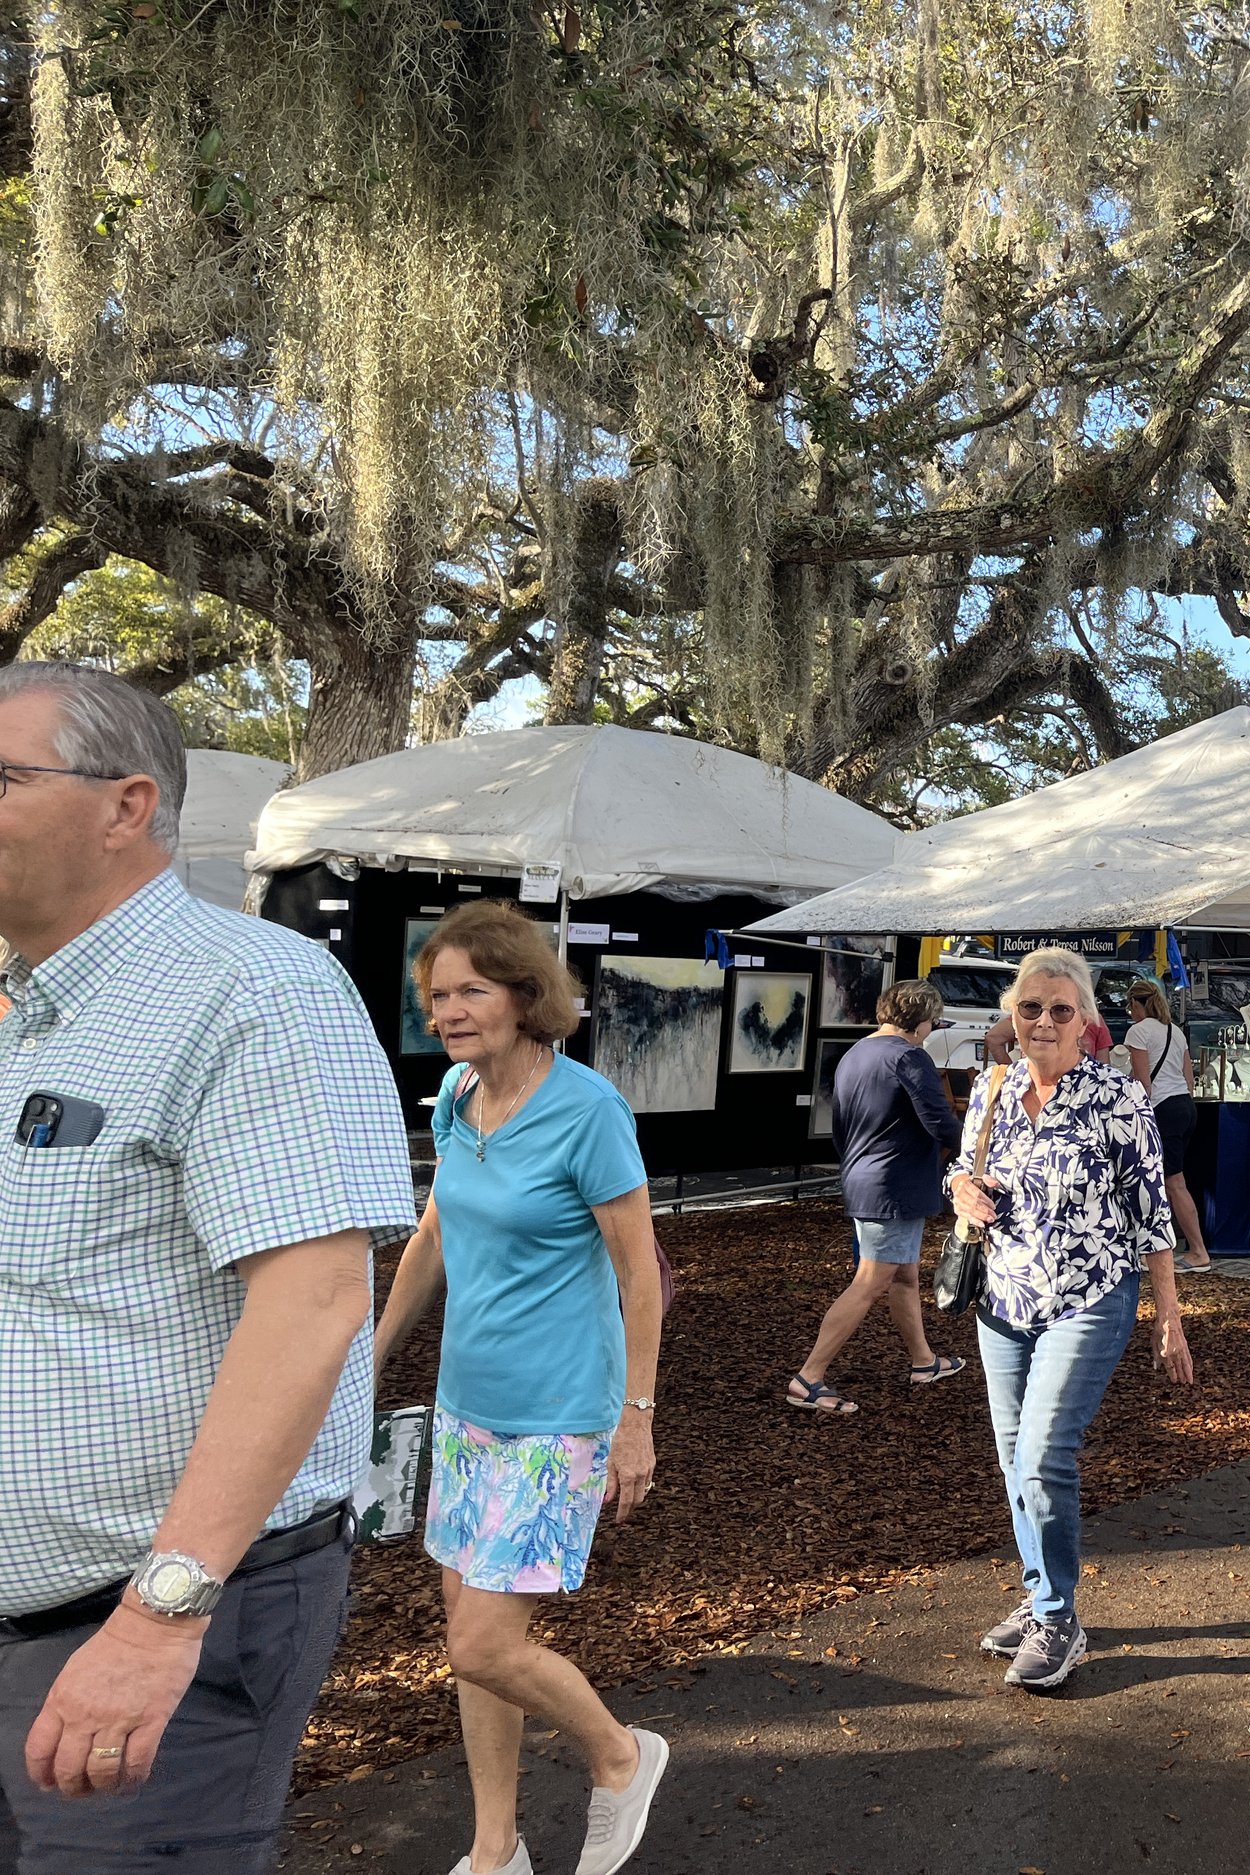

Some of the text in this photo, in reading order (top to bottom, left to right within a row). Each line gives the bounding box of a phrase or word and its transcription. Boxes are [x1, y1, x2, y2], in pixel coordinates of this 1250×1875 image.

[1003, 936, 1115, 951] Robert & Teresa Nilsson
